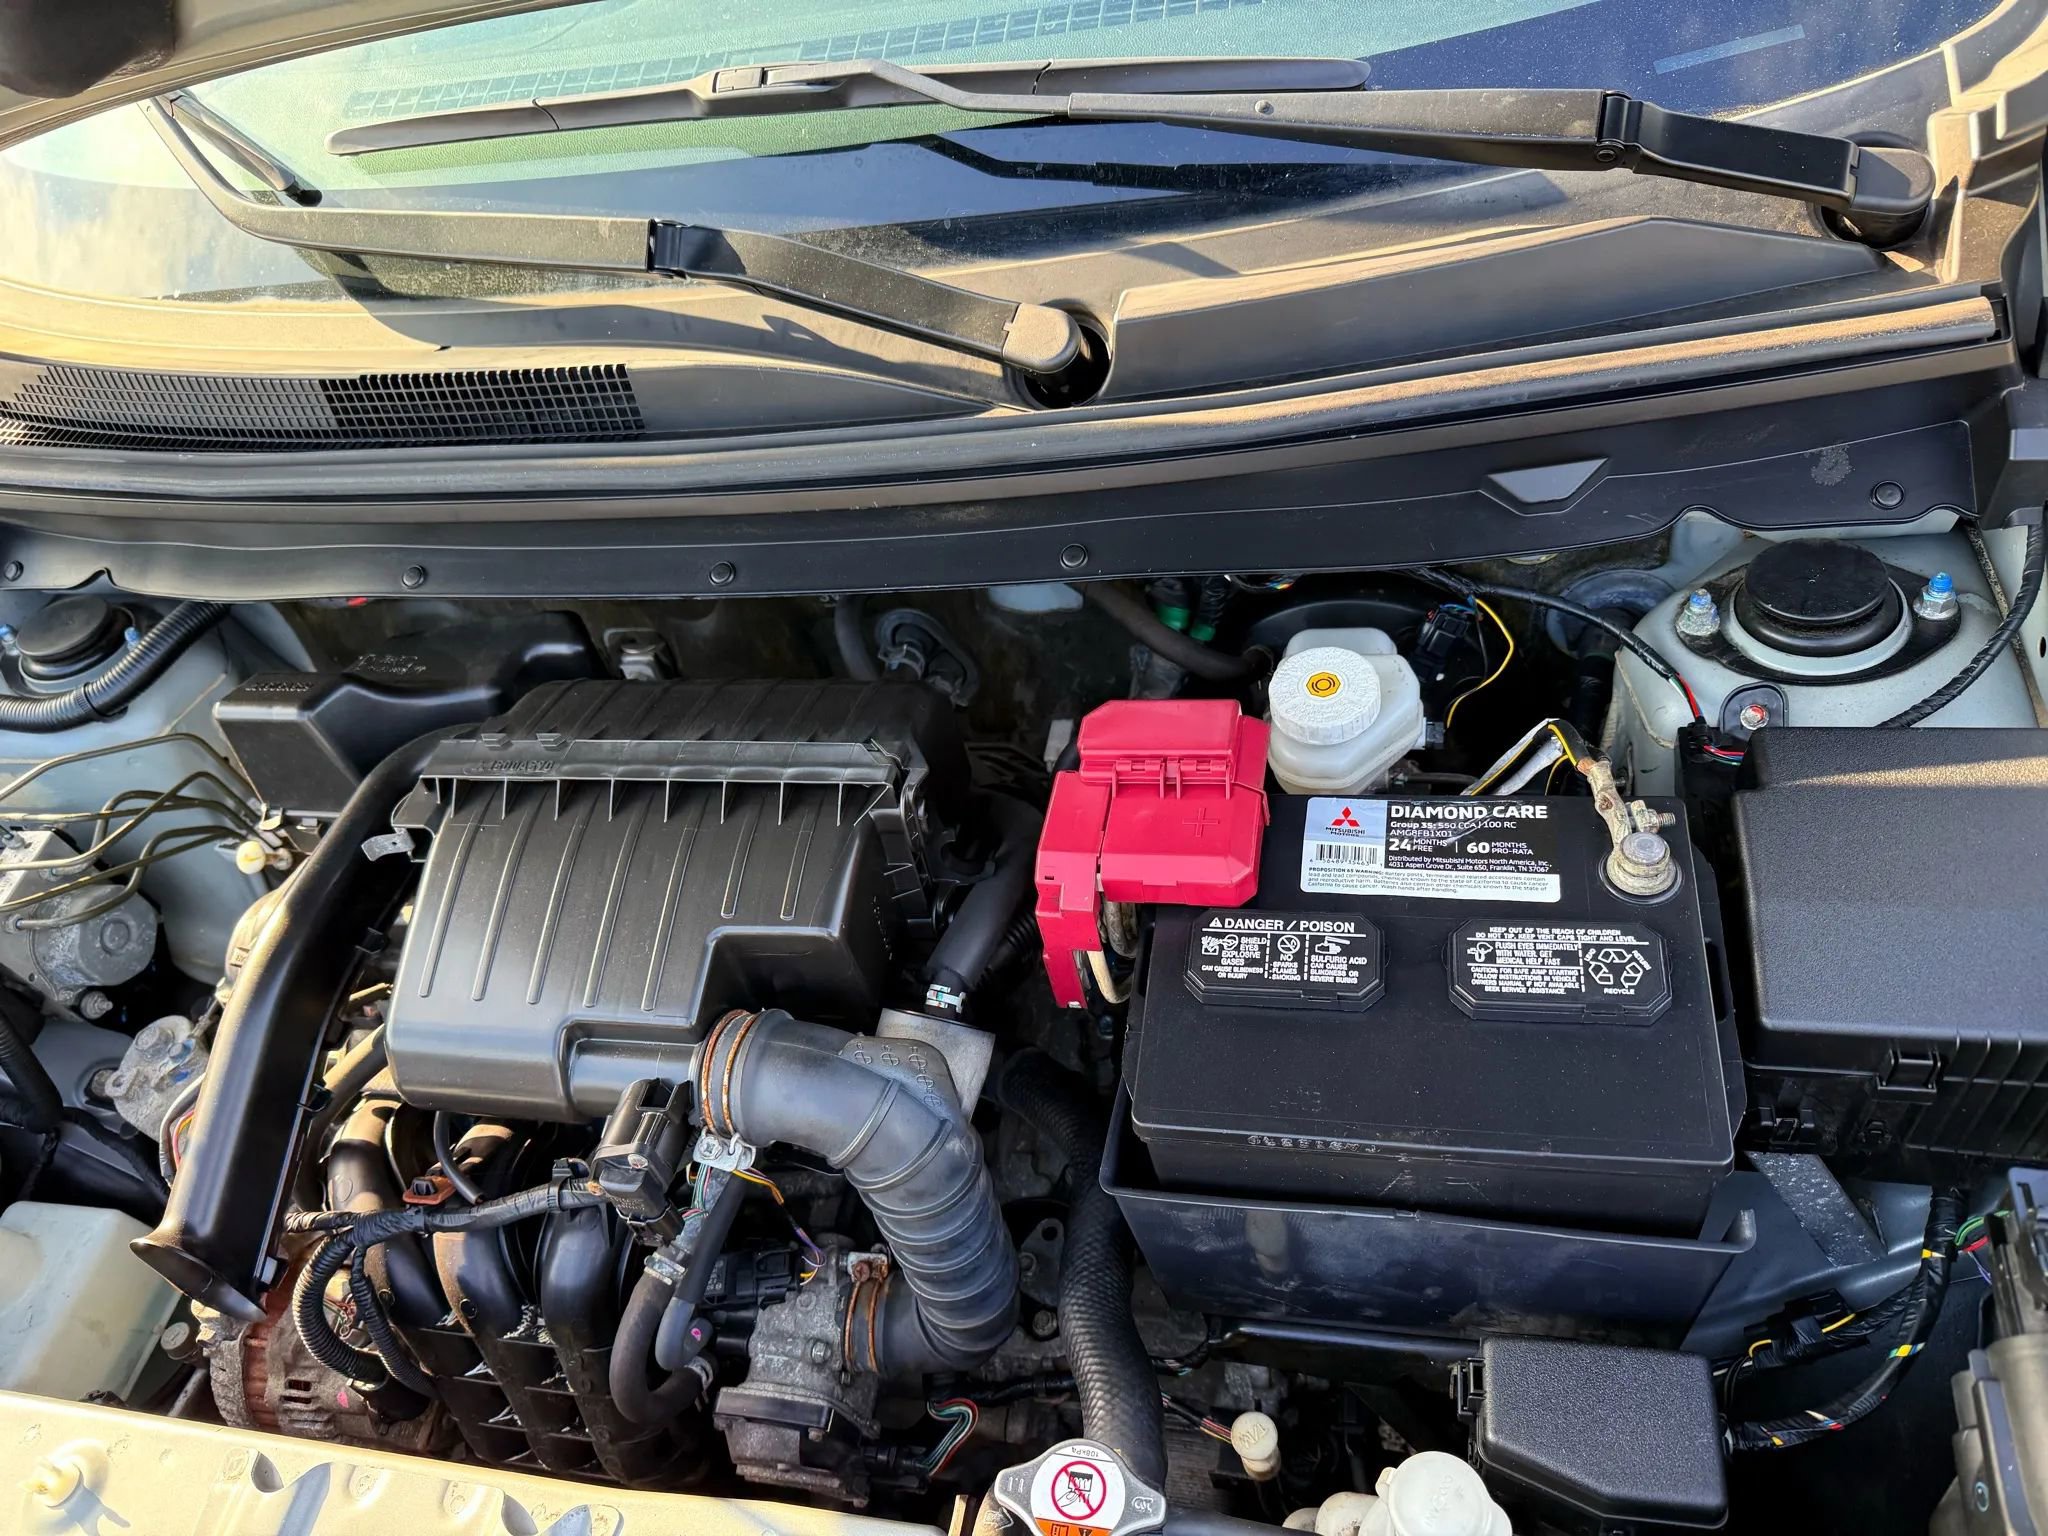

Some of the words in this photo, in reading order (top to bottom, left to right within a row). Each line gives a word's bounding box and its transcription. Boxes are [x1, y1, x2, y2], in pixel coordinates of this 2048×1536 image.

[1391, 805, 1487, 819] DIAMOND
[1492, 805, 1548, 819] CARE
[1390, 821, 1419, 830] Group
[1421, 821, 1436, 829] 35:
[1503, 821, 1517, 829] RC
[1325, 826, 1365, 835] MITSUBISHI
[1388, 838, 1411, 851] 24
[1413, 838, 1448, 847] MONTHS
[1491, 841, 1527, 849] MONTHS
[1466, 842, 1490, 854] 60
[1491, 847, 1533, 855] PRO-RATA
[1424, 856, 1431, 864] by
[1508, 859, 1537, 867] America,
[1405, 862, 1424, 870] Aspen
[1445, 863, 1456, 871] Dr.,
[1489, 864, 1517, 872] Franklin,
[1224, 918, 1284, 930] DANGER
[1299, 920, 1355, 933] POISON
[1240, 936, 1267, 945] SHIELD
[1517, 942, 1534, 950] EYES
[1535, 943, 1578, 951] IMMEDIATELY
[1221, 950, 1261, 958] EXPLOSIVE
[1280, 953, 1294, 961] NO
[1495, 949, 1512, 957] WITH
[1539, 950, 1553, 958] GET
[1584, 948, 1597, 962] LEAD
[1220, 958, 1245, 966] GASES
[1310, 954, 1347, 964] SULFURIC
[1348, 956, 1367, 965] ACID
[1495, 956, 1524, 964] MEDICAL
[1525, 957, 1543, 965] HELP
[1631, 949, 1652, 971] RETURN
[1233, 966, 1264, 974] BLINDNESS
[1310, 968, 1346, 977] BLINDNESS
[1309, 975, 1334, 983] SEVERE
[1335, 976, 1358, 984] BURNS
